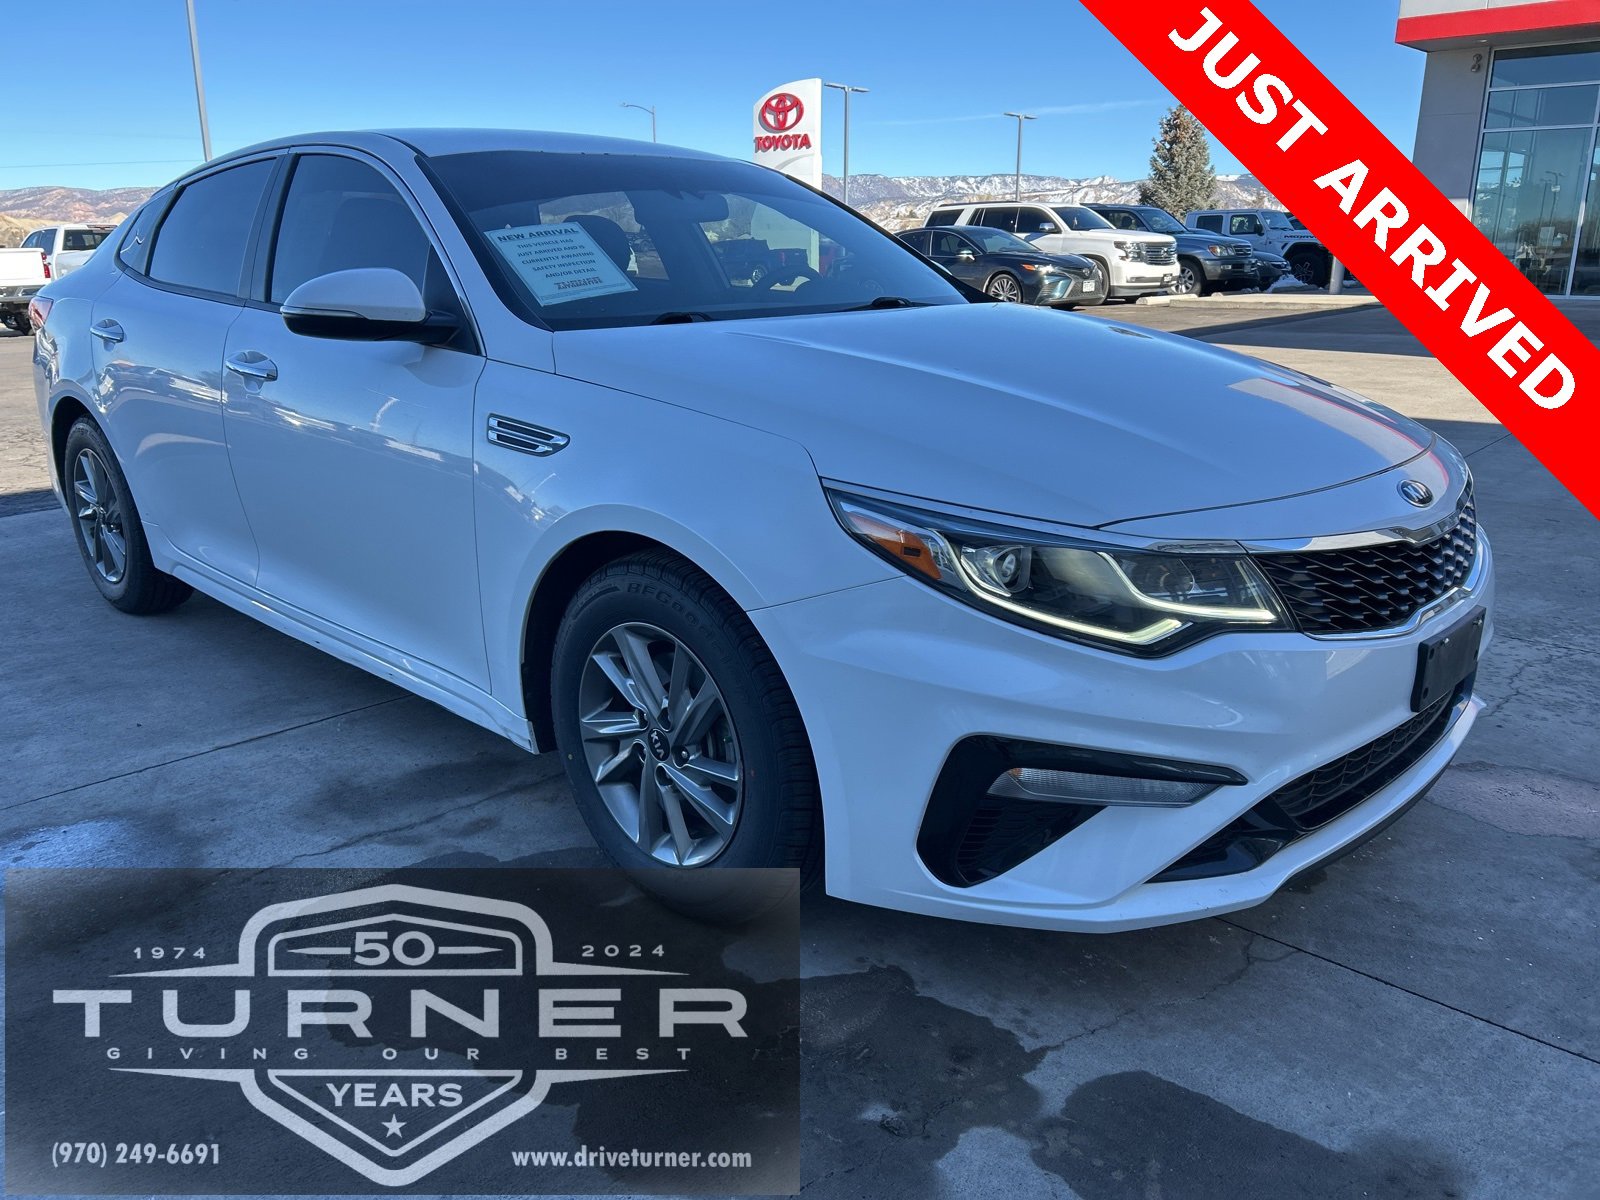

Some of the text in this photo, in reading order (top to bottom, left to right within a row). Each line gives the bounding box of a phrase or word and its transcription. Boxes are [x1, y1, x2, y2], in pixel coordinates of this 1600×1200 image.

[754, 133, 812, 153] TOYOTA
[497, 228, 579, 241] NEW ARRIVAL
